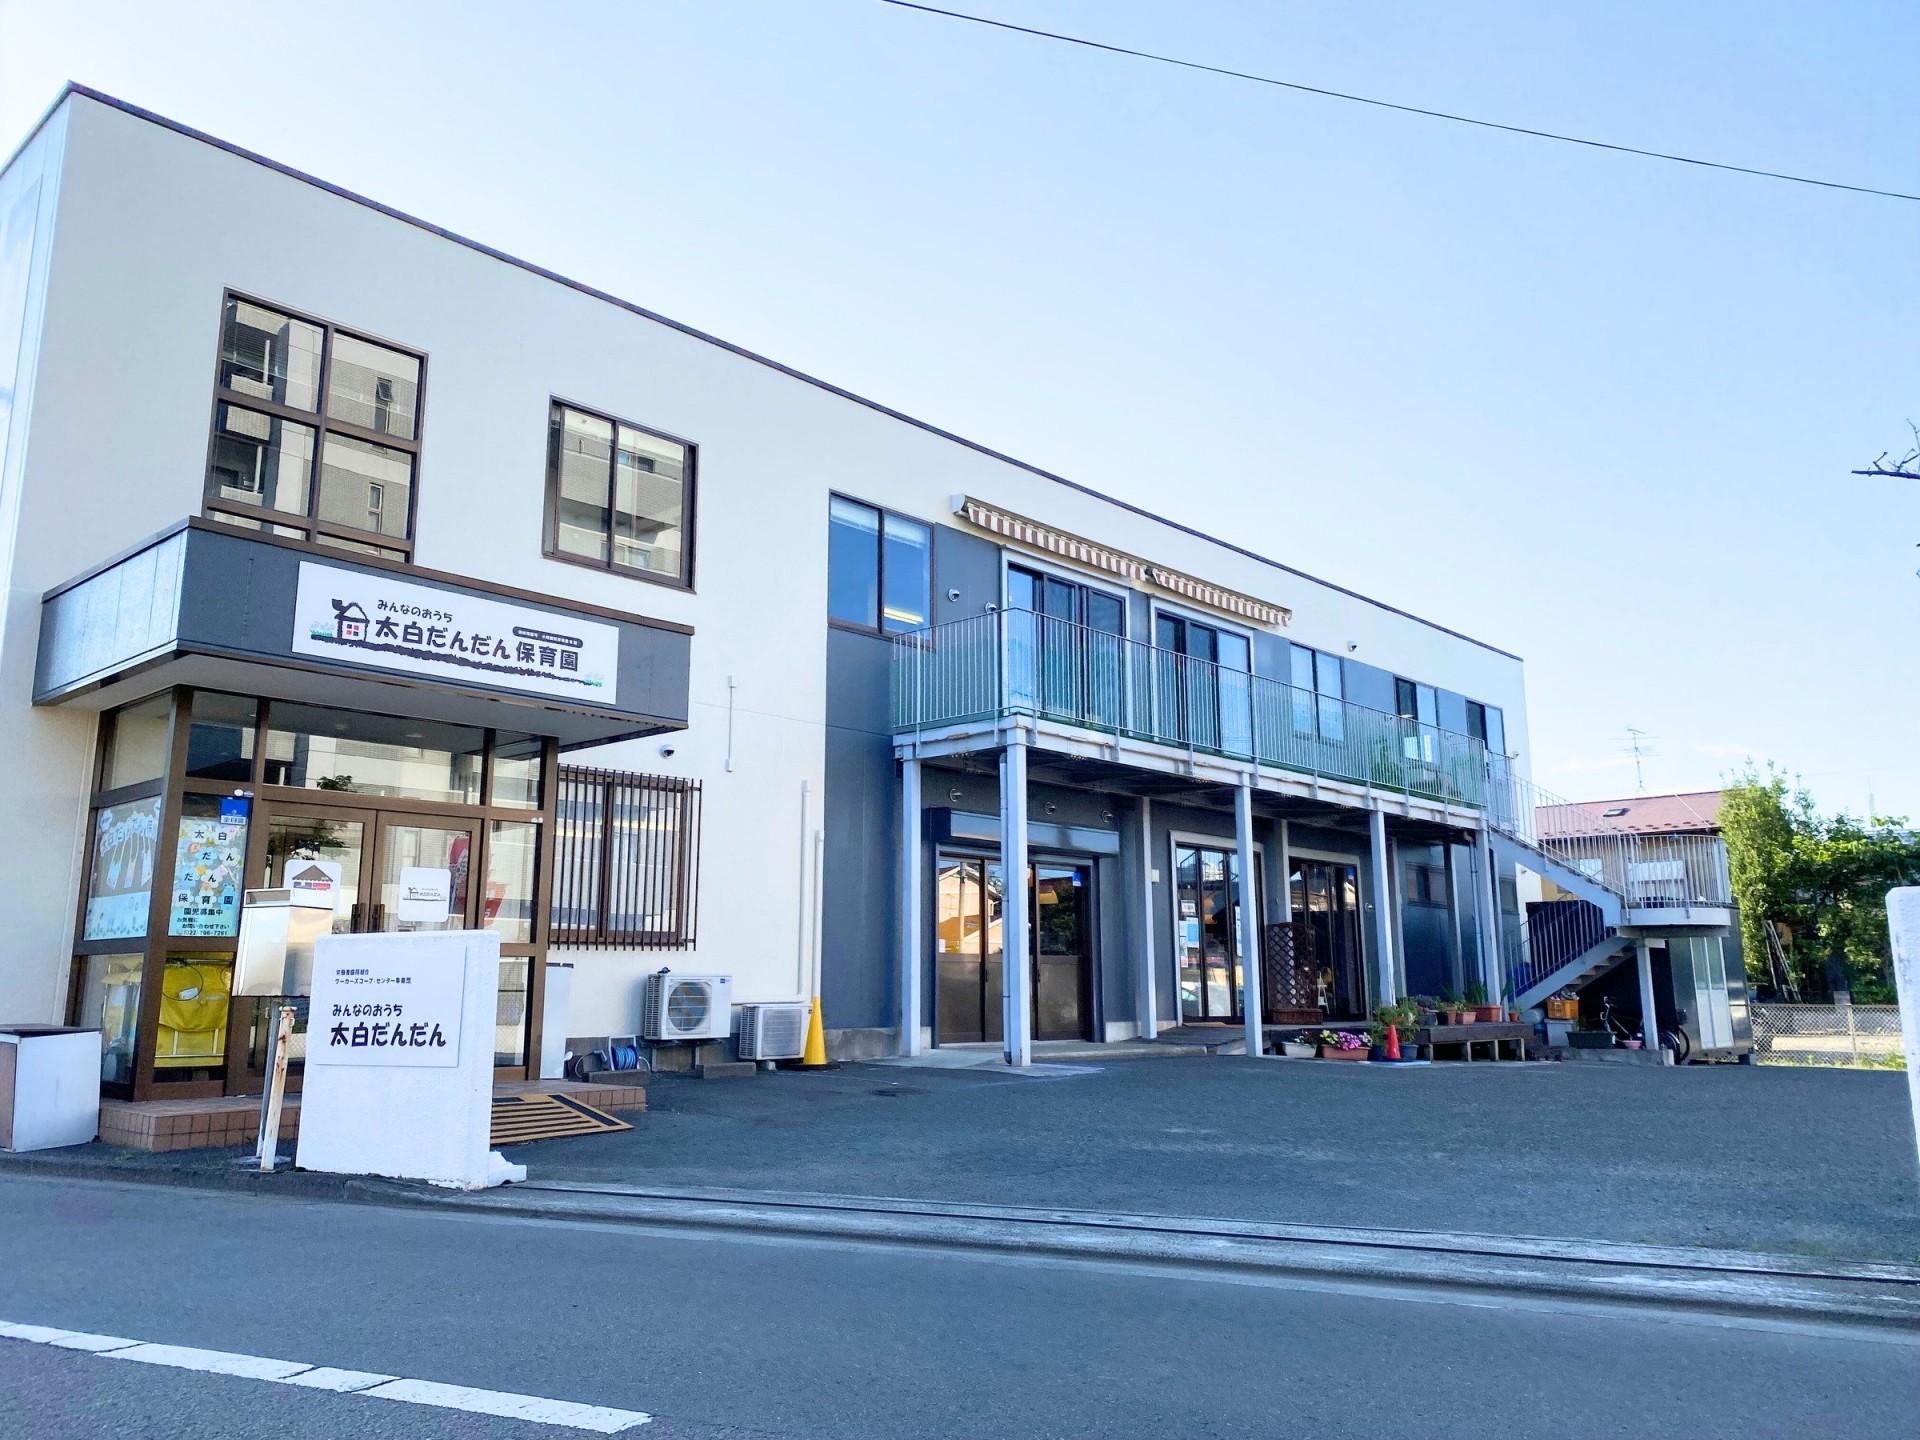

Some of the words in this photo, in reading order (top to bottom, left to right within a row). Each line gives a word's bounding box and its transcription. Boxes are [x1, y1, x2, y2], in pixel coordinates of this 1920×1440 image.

[377, 599, 453, 624] みんなのおうち
[375, 615, 579, 672] 太白だんだん保育園
[332, 1004, 403, 1017] みんなのおうち
[330, 1022, 447, 1048] 太白だんだん
